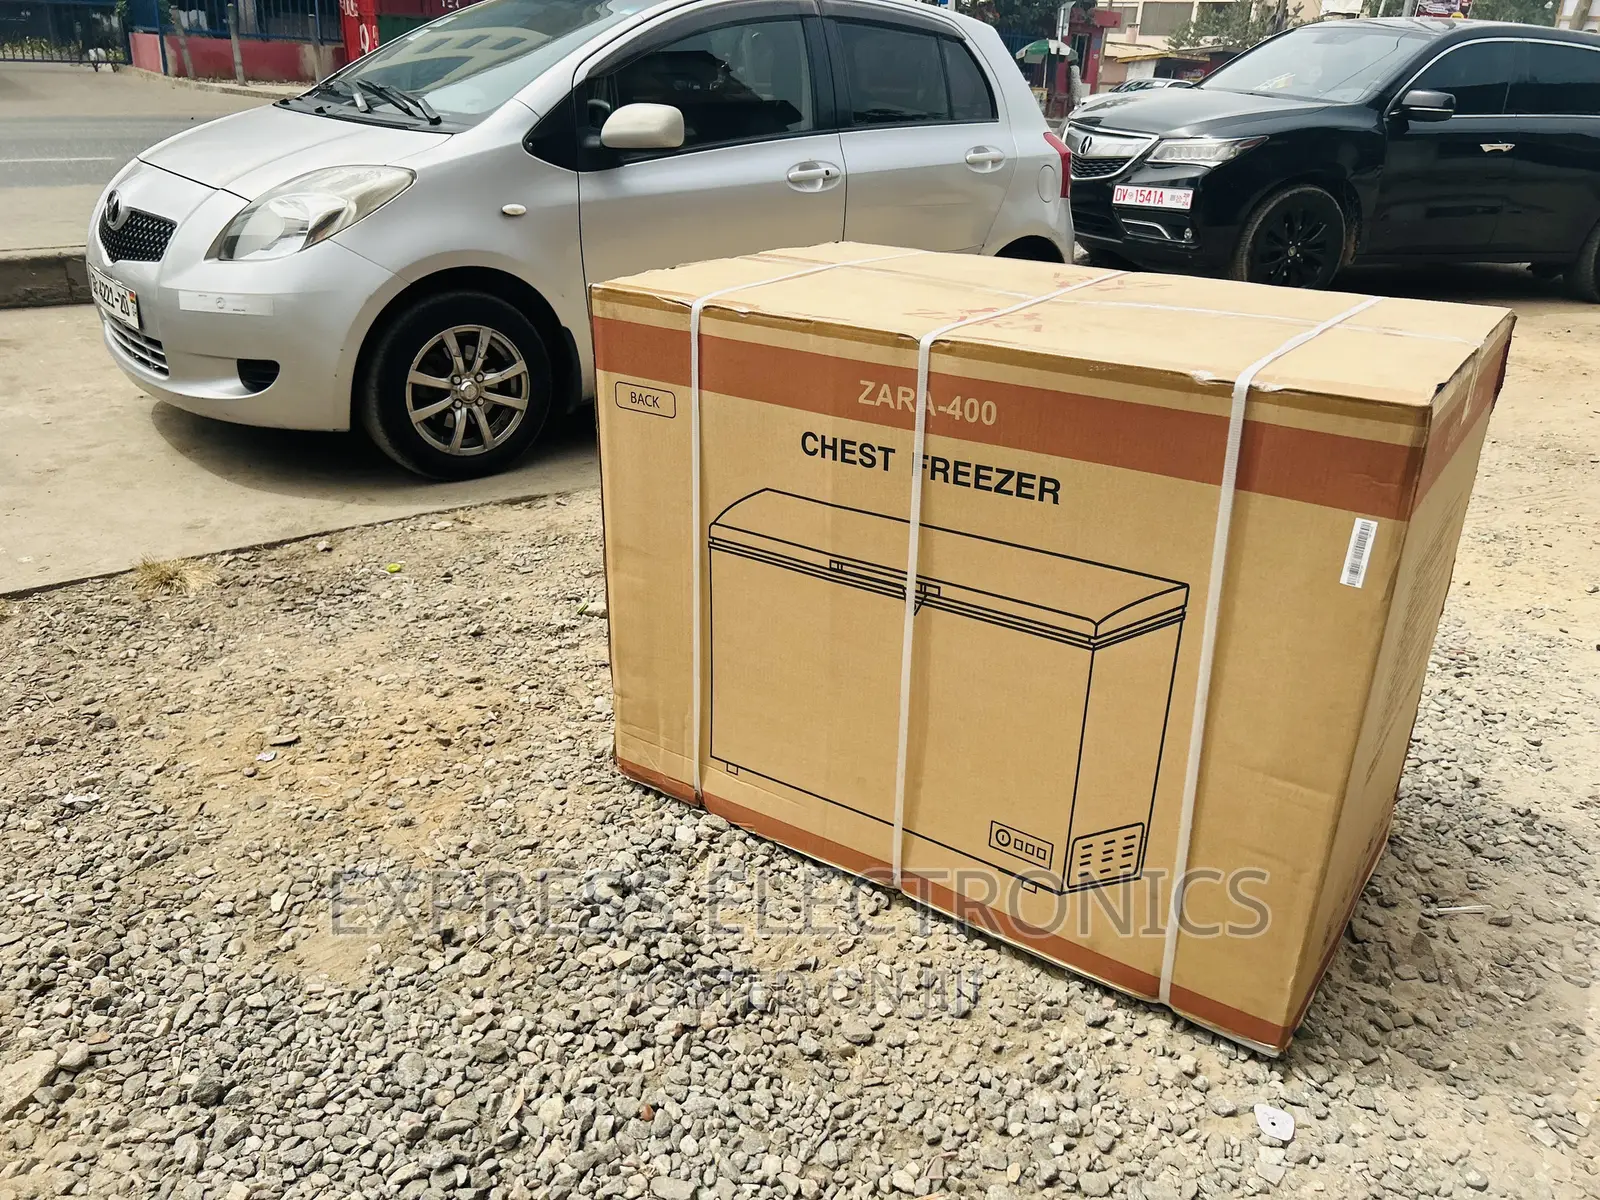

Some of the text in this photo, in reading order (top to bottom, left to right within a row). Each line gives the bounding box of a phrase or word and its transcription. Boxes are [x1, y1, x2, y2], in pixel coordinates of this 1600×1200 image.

[1114, 188, 1164, 205] DV 1541A
[630, 391, 661, 409] BACK
[801, 431, 896, 471] CHEST
